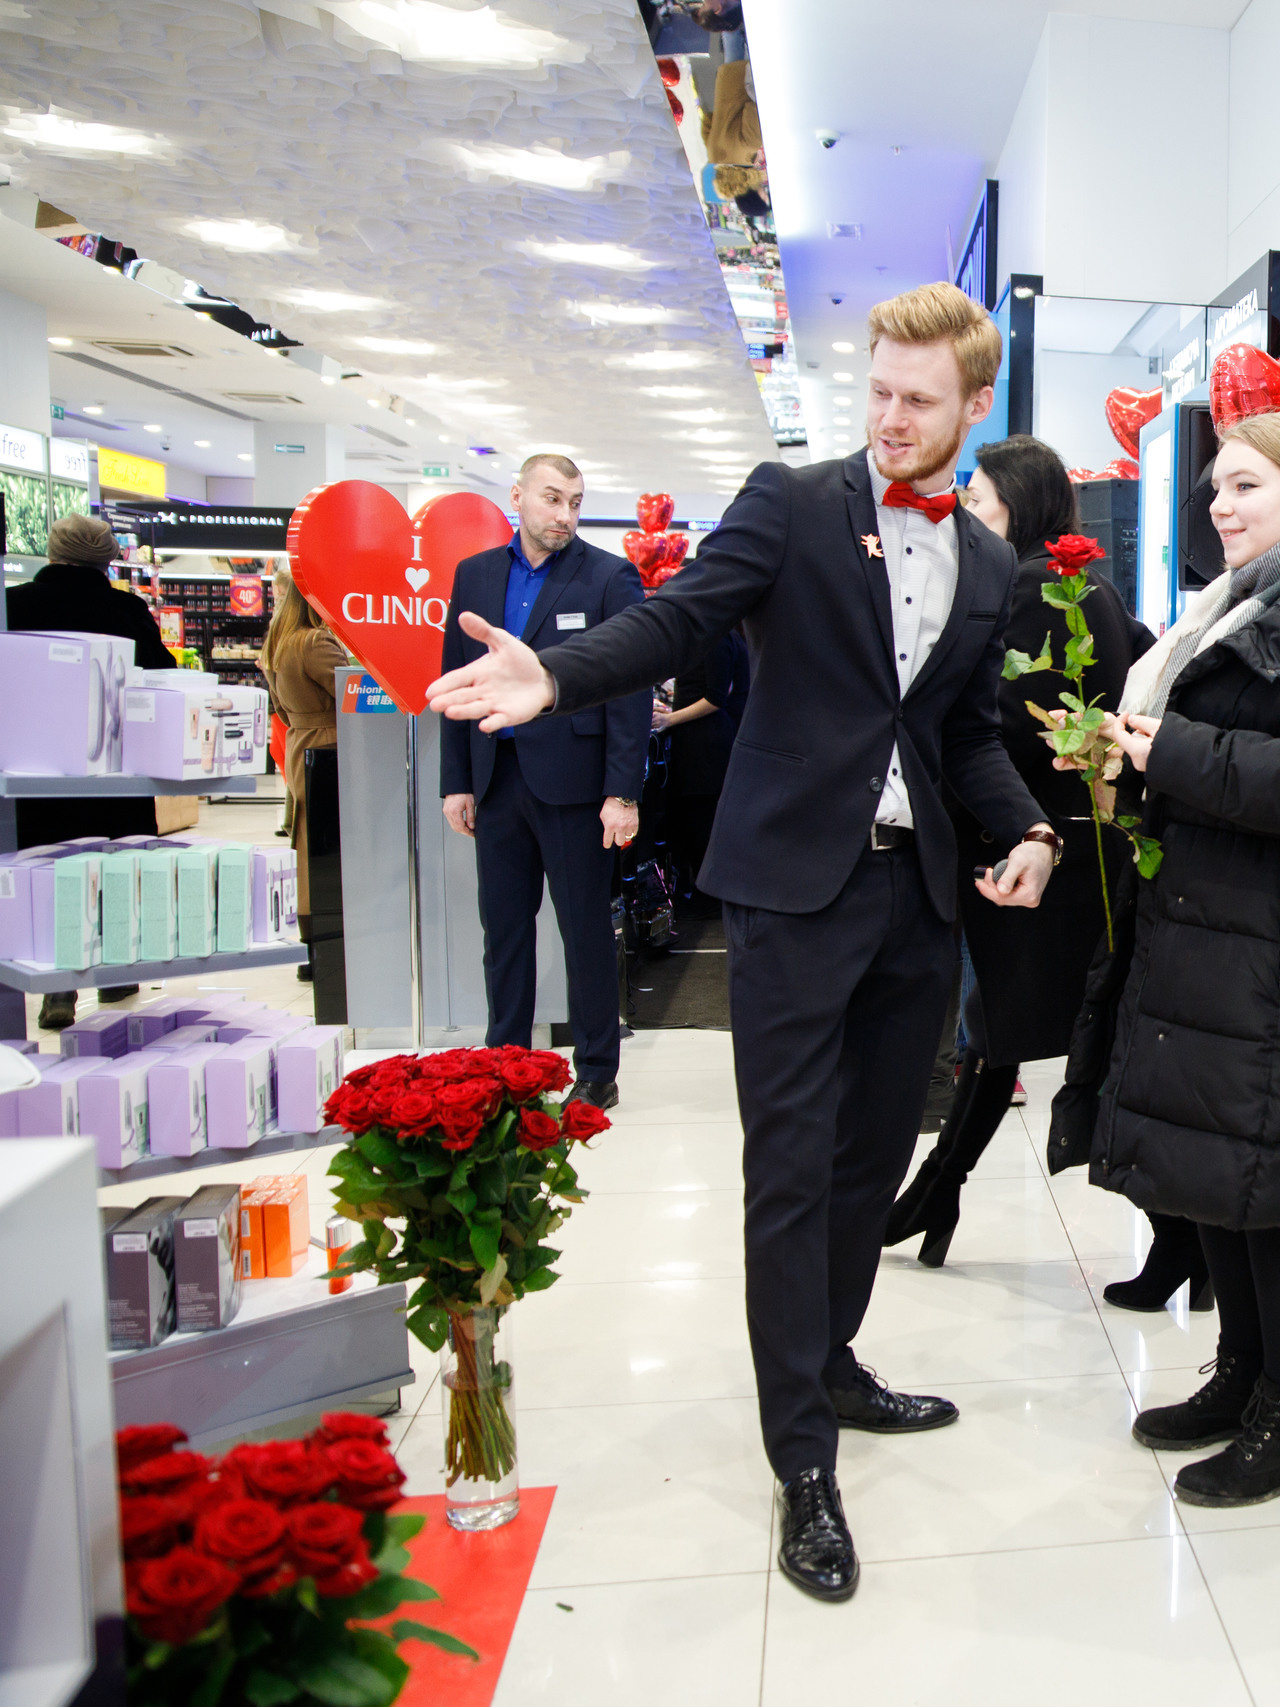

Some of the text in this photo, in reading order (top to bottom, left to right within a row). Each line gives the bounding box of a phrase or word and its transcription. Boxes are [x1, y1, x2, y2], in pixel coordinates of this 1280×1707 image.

[2, 433, 26, 459] free
[189, 514, 284, 526] PROFESSIONAL
[411, 535, 422, 561] I
[341, 592, 451, 632] CLINIQ
[347, 683, 384, 695] UnionP
